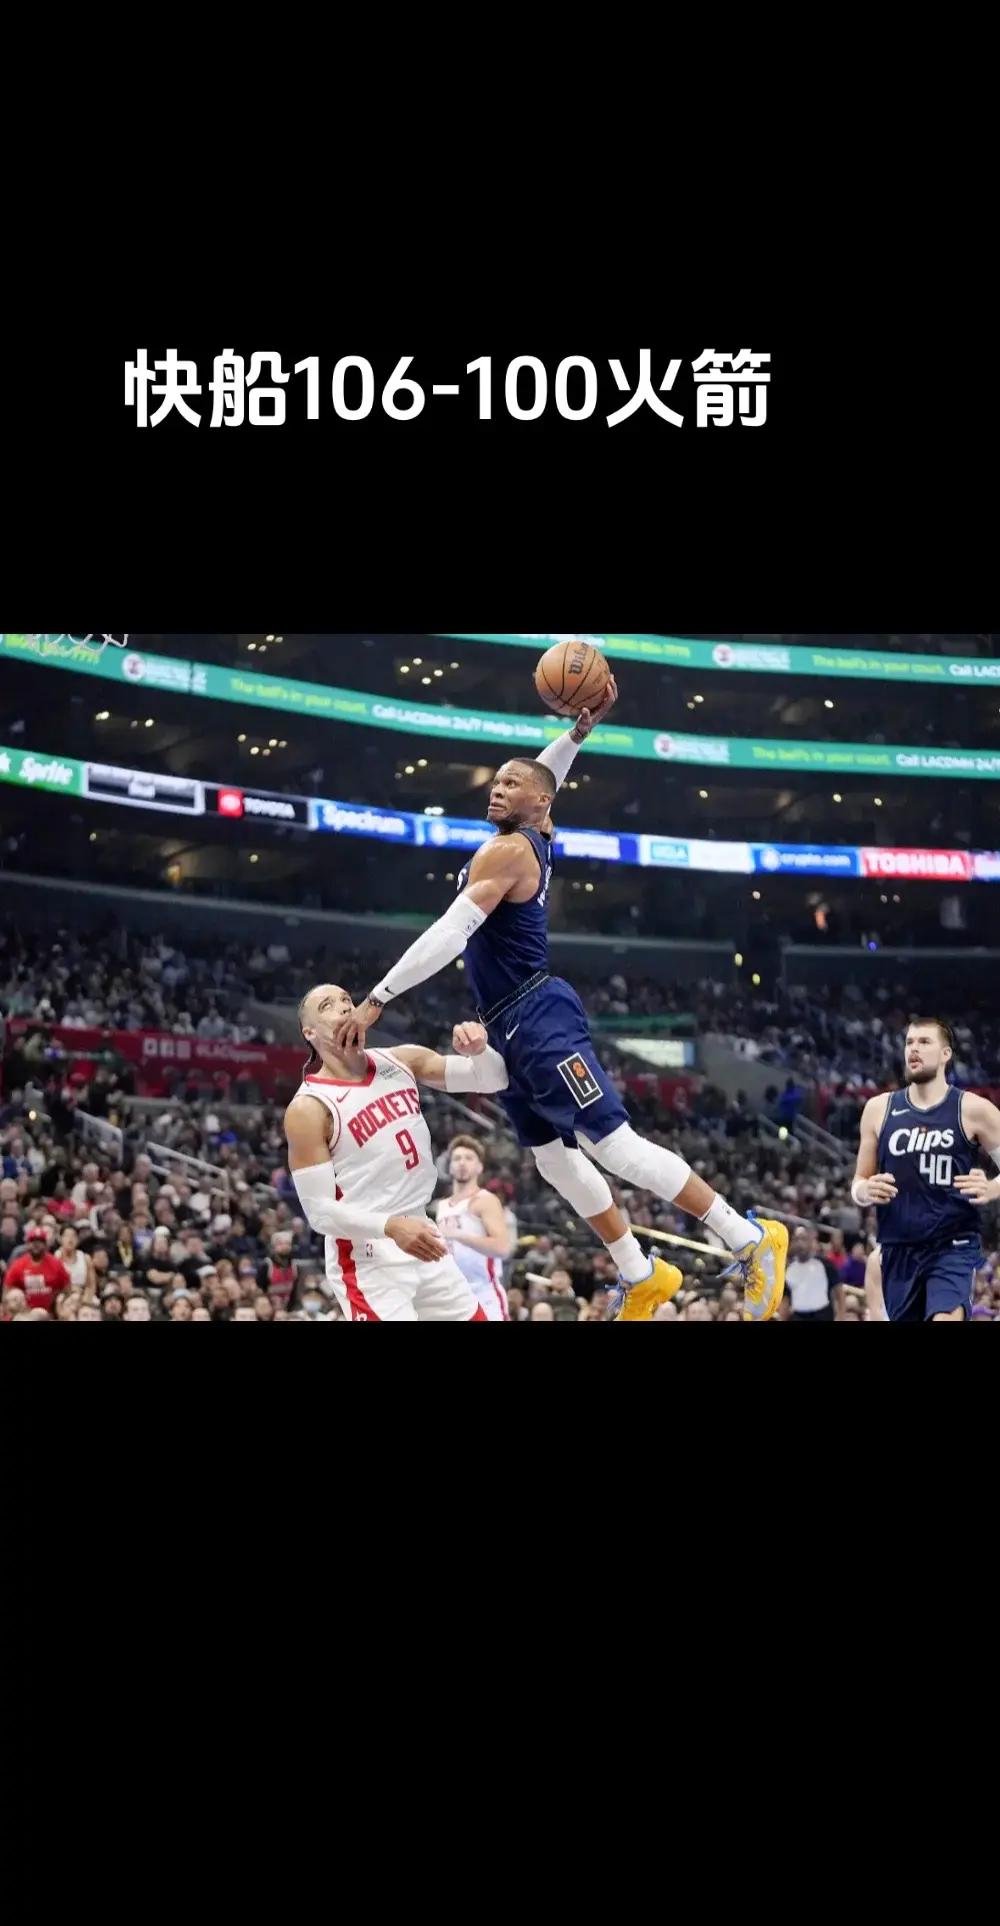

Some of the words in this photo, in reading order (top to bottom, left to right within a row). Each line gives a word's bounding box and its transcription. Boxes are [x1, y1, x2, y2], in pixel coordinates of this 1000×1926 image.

[19, 756, 73, 785] Sprite
[243, 797, 295, 819] TOYOTA
[323, 804, 405, 835] Spectrum
[780, 852, 851, 868] crypto.com
[866, 852, 964, 876] TOSHIBA
[347, 1087, 420, 1148] ROCKETS
[395, 1128, 419, 1170] 9
[888, 1125, 954, 1156] Clips
[920, 1153, 952, 1186] 40
